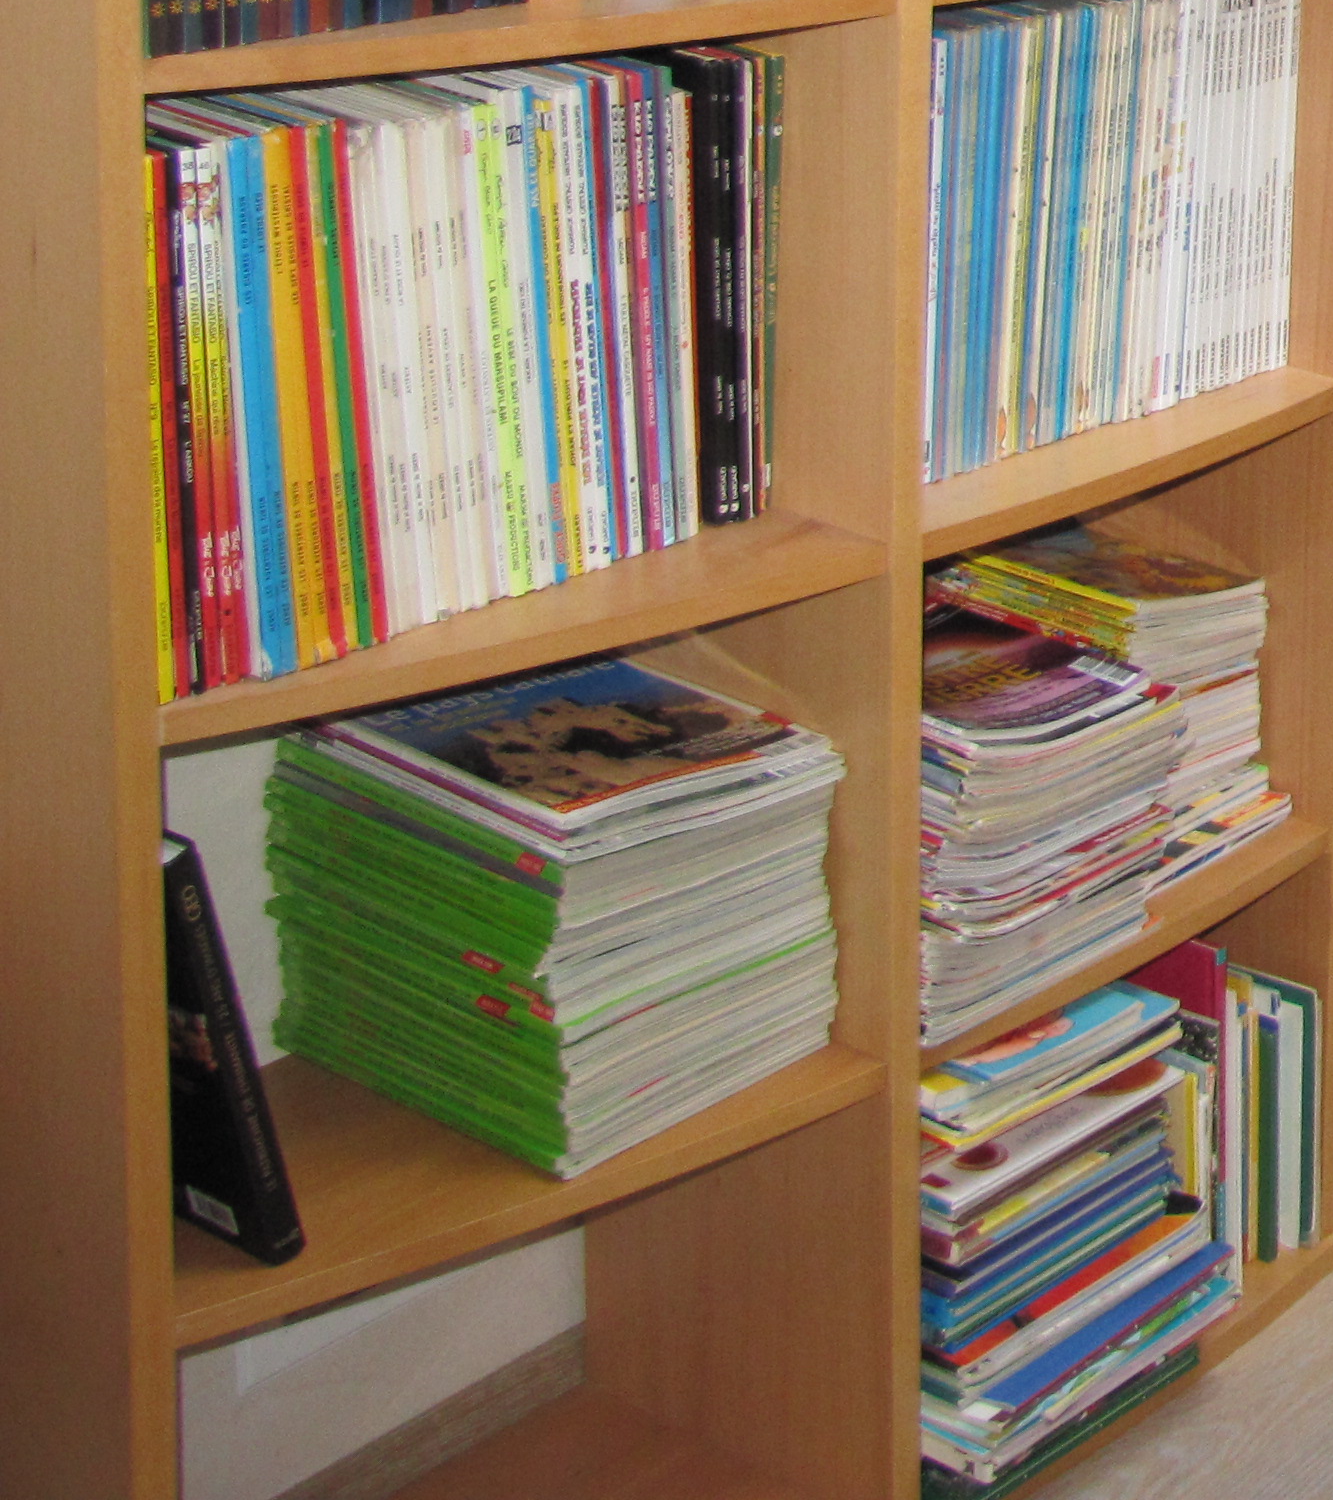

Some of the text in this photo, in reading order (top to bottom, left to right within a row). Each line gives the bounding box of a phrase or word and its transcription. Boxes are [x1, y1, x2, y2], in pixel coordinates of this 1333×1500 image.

[204, 240, 214, 280] SPIROU
[187, 240, 200, 342] SPIROU ET FANTASIO
[206, 282, 216, 295] ET
[206, 296, 217, 342] FANTASIO
[208, 356, 218, 392] Machine
[488, 280, 520, 571] LA QUEUE DU MARSUPILAMI MARSU PRODUCTIONS
